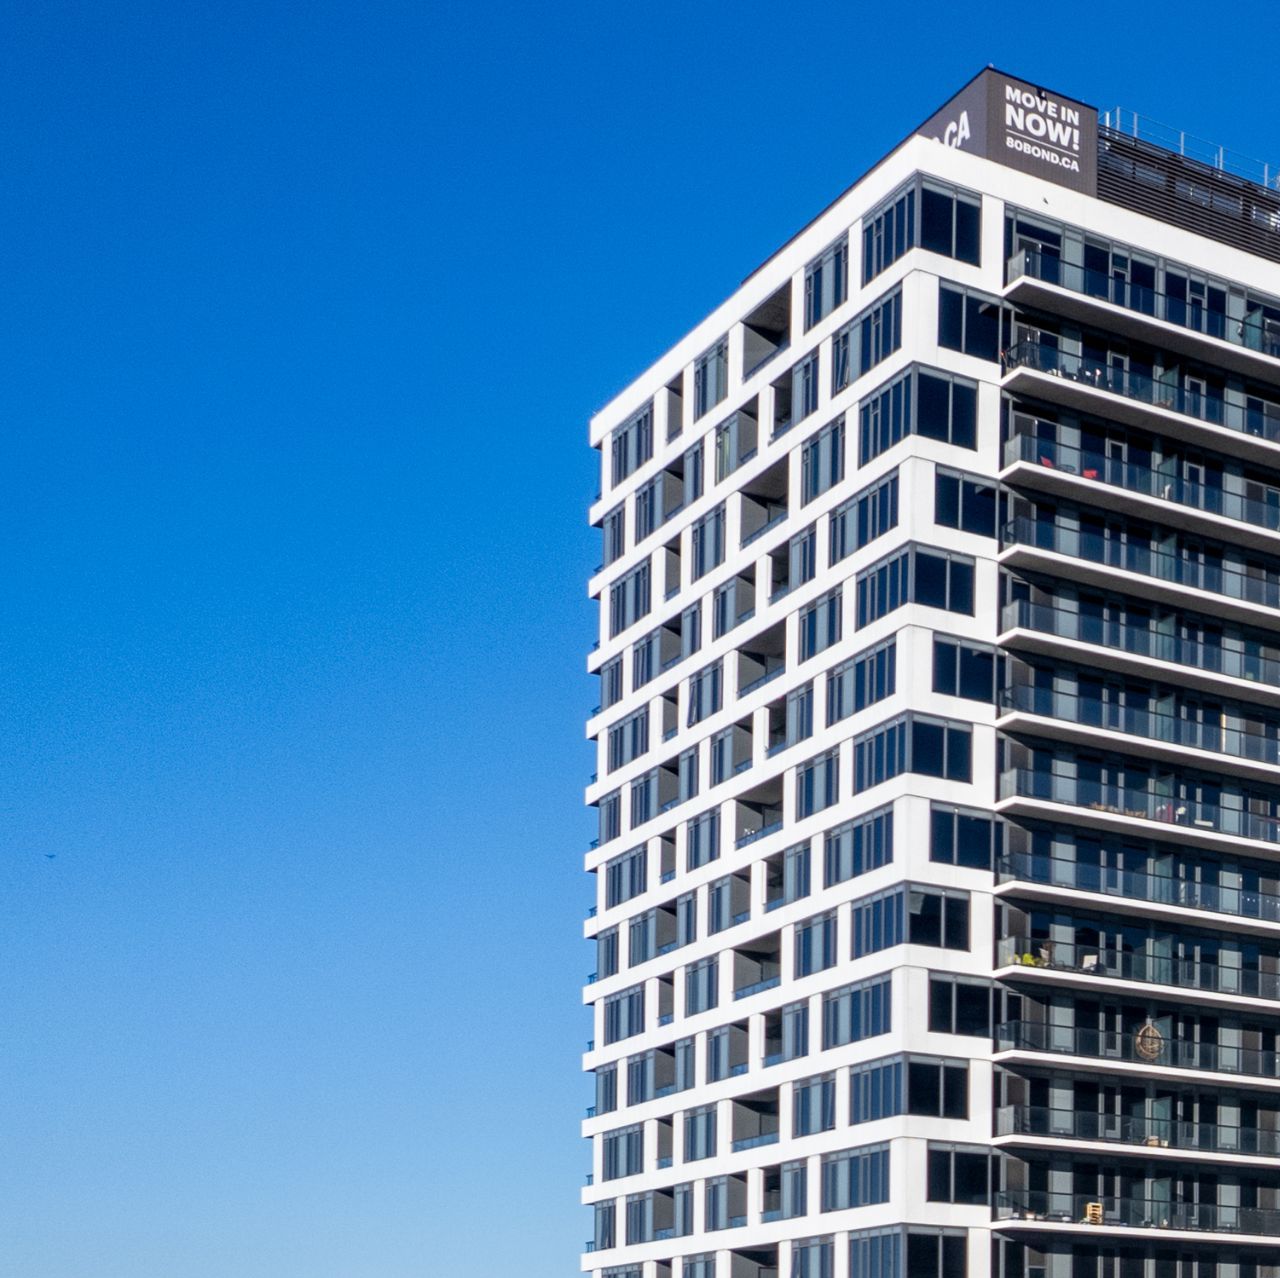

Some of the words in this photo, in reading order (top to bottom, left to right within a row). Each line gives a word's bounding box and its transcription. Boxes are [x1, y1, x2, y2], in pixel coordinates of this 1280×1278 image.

[1005, 85, 1058, 118] MOVE
[1061, 106, 1080, 126] IN
[1005, 103, 1080, 151] NOW!
[1006, 136, 1080, 173] 80BOND.CA
